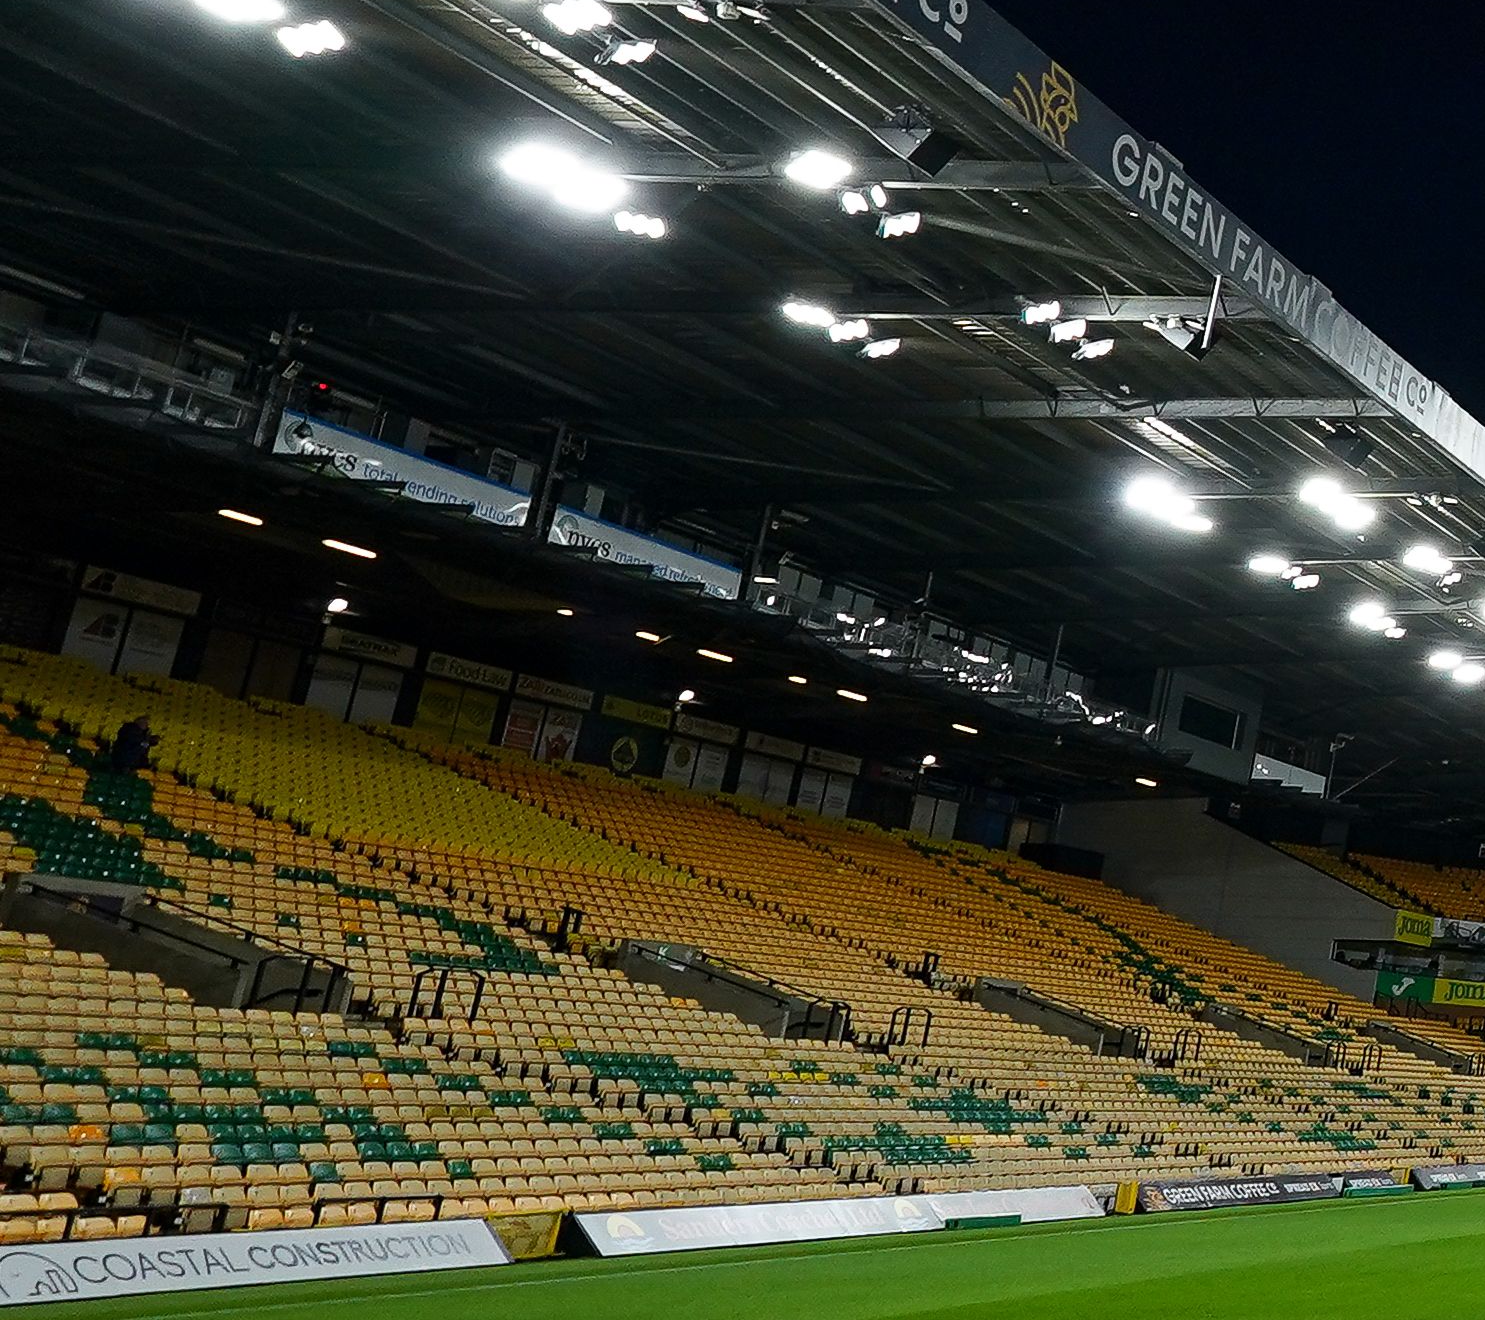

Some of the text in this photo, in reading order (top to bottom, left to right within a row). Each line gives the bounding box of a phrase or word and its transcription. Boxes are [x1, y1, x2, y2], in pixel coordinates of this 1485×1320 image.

[1112, 133, 1227, 259] GREEN
[1230, 228, 1315, 320] FARM
[1163, 1186, 1201, 1205] GREEN
[1201, 1184, 1232, 1202] FARM
[1230, 1183, 1270, 1200] COFFEE
[73, 1233, 470, 1284] COASTAL CONSTRUCTION
